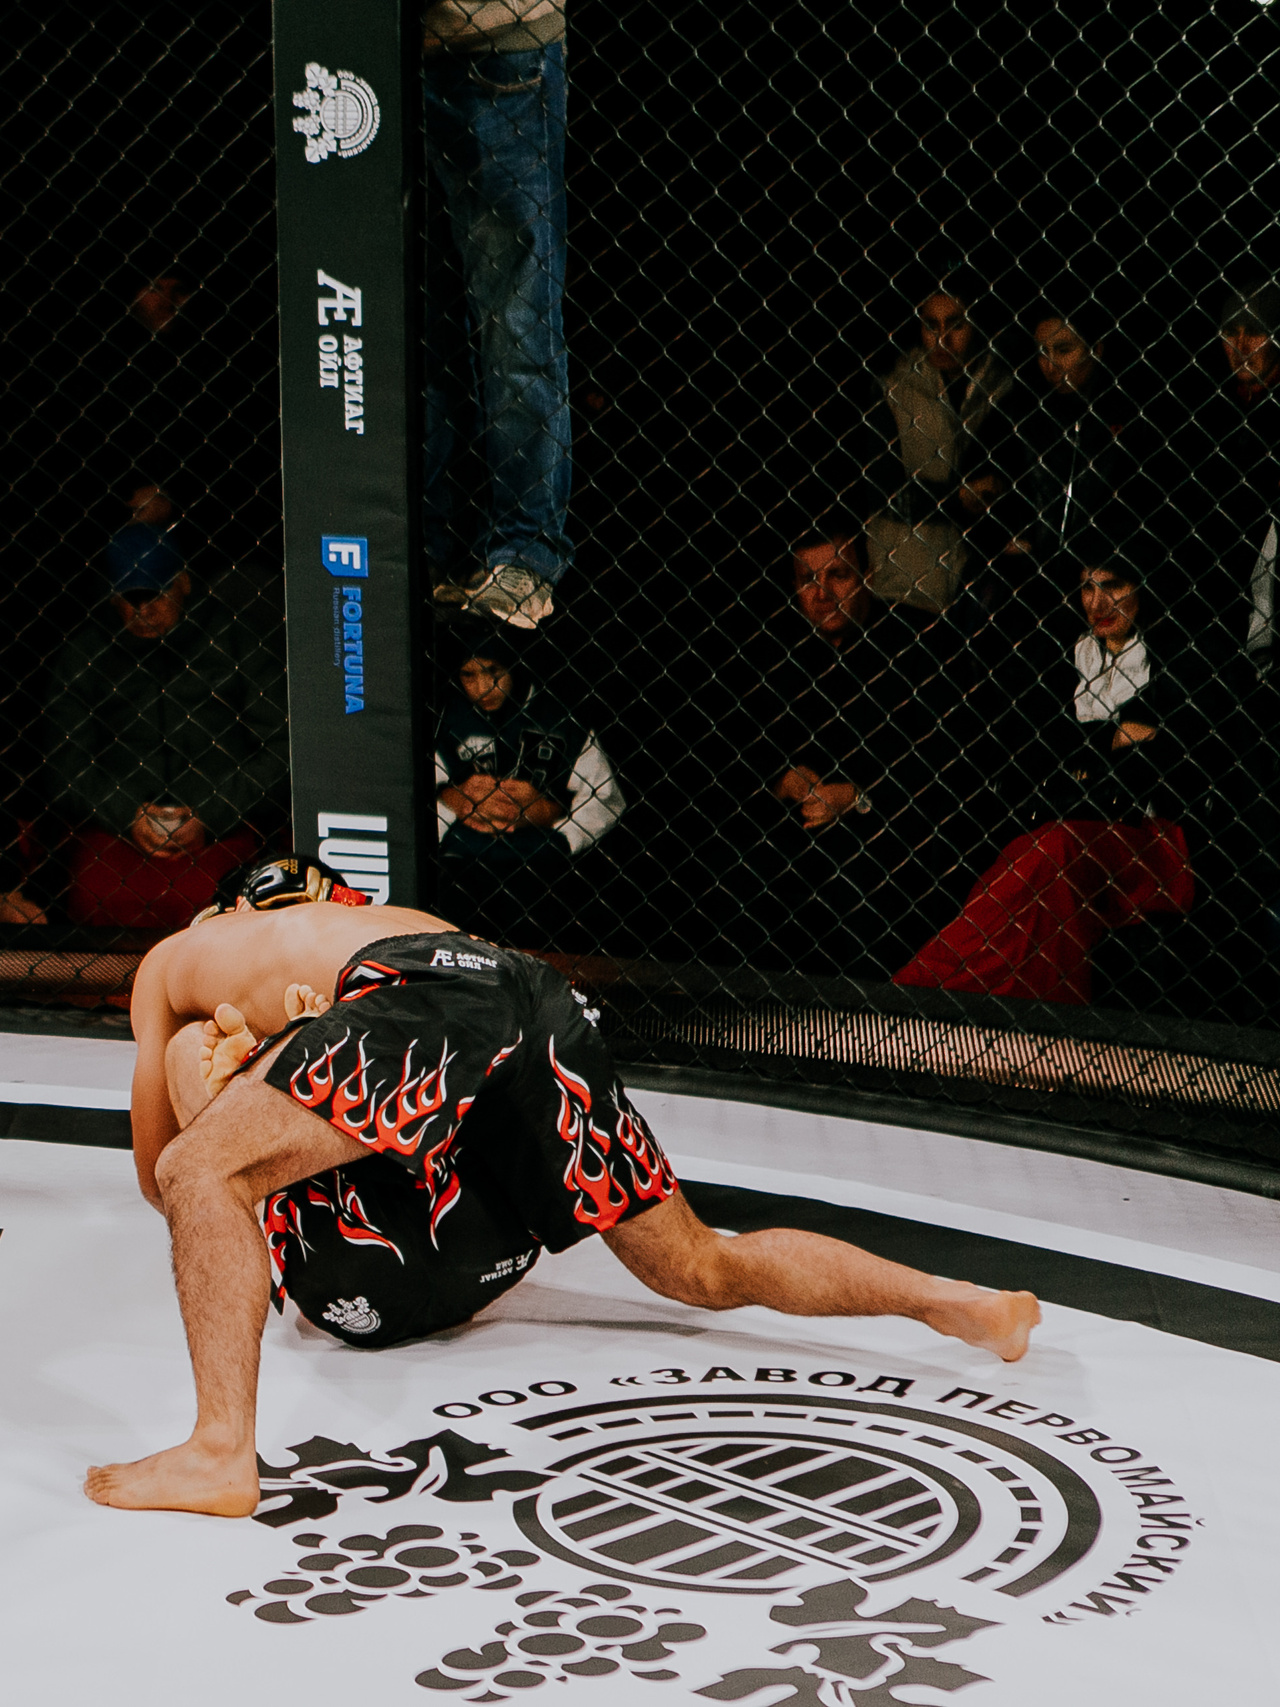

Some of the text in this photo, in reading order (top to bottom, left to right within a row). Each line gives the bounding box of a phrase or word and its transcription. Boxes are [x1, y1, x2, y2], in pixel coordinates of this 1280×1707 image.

[318, 333, 342, 389] ОЙЛ
[343, 333, 365, 435] АФТИАГ
[342, 585, 365, 716] FORTUNA
[432, 1380, 578, 1419] ООО
[609, 1366, 917, 1398] «ЗАВОД
